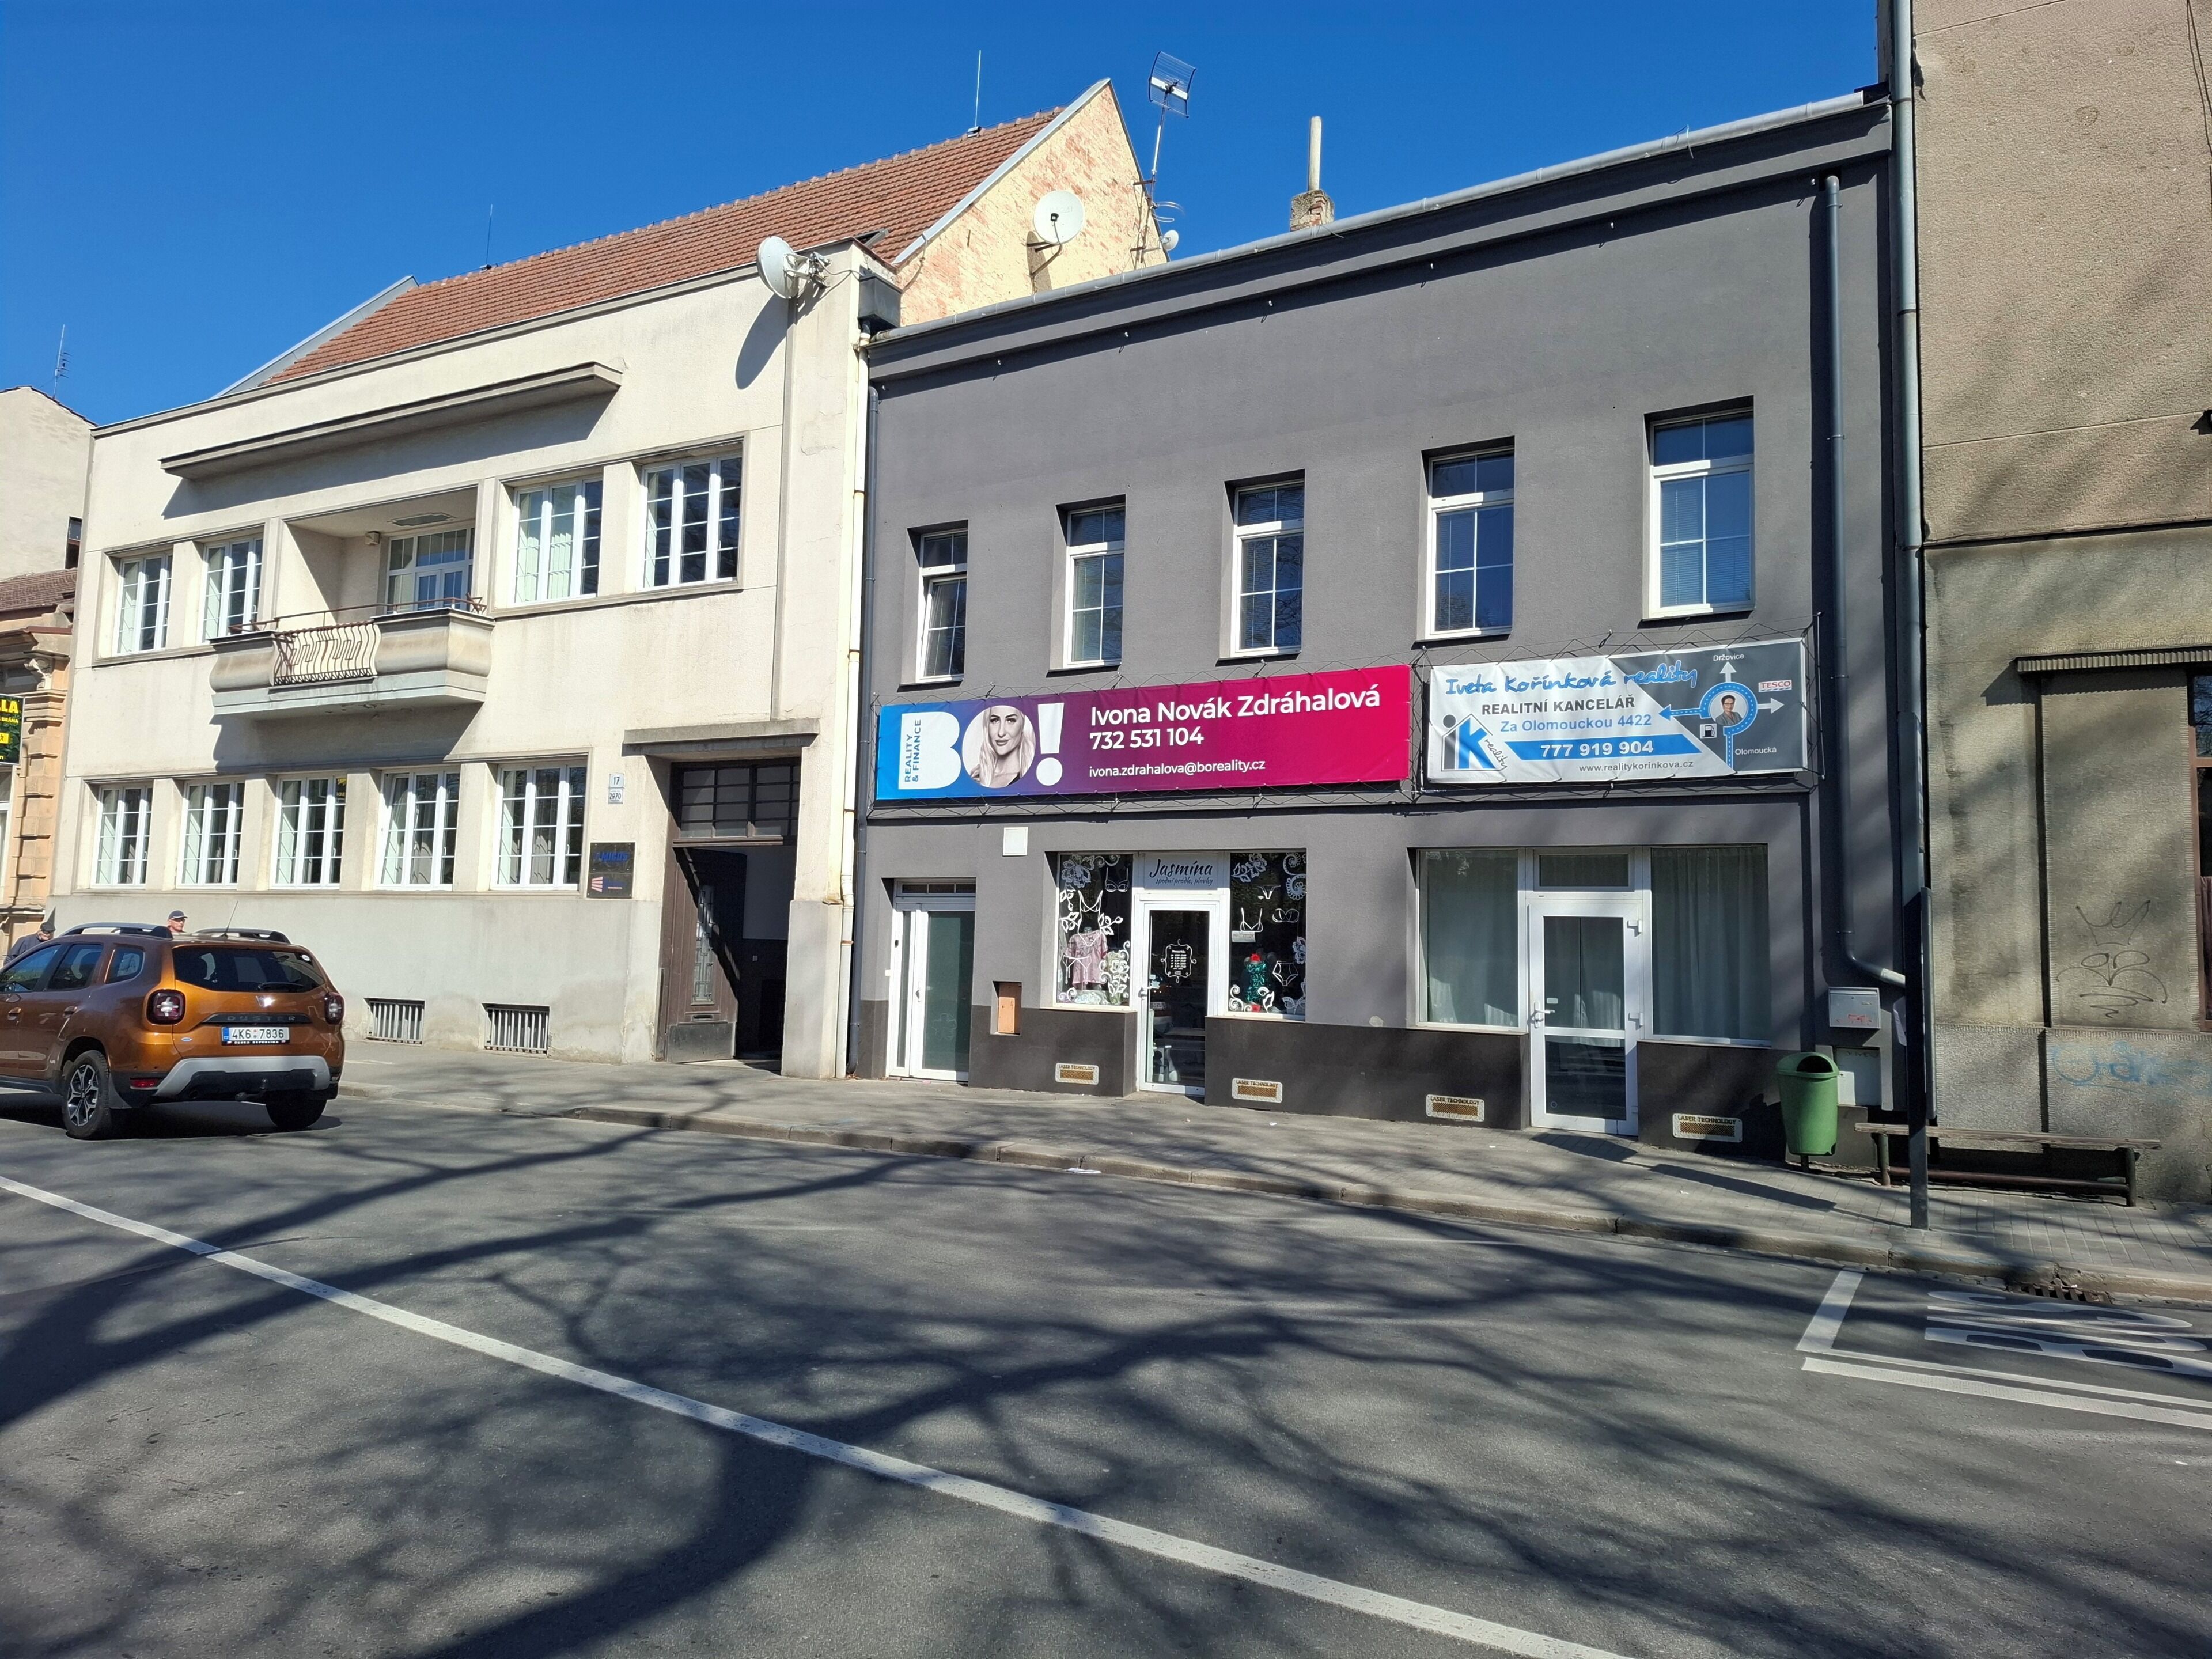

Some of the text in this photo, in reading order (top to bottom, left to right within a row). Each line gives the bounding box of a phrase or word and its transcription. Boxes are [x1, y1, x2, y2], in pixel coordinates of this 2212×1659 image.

[1445, 660, 1698, 695] Iveta Kořínková reality
[1760, 680, 1791, 689] TESCO
[0, 699, 18, 714] LA
[1091, 684, 1380, 726] Ivona Novák Zdráhalová
[1482, 694, 1635, 715] REALITNÍ KANCELÁŘ
[1500, 714, 1652, 732] Za Olomouckou 4422
[1090, 726, 1205, 750] 732 531 104
[912, 719, 922, 782] & FINANCE
[1484, 739, 1508, 770] reality
[1540, 740, 1654, 757] 777 919 904
[1734, 746, 1777, 755] Olomoucká
[904, 734, 913, 782] REALITY
[1578, 760, 1694, 772] www.realitykorinkova.cz
[1089, 759, 1266, 777] ivona.zdrahalova@boreality.cz
[613, 776, 620, 785] 17
[1149, 858, 1213, 878] Jasmína
[1156, 876, 1213, 887] spodní prádlo, plavky
[232, 1029, 285, 1039] 4K6 7836
[1698, 1117, 1737, 1125] TECHNOLOGY
